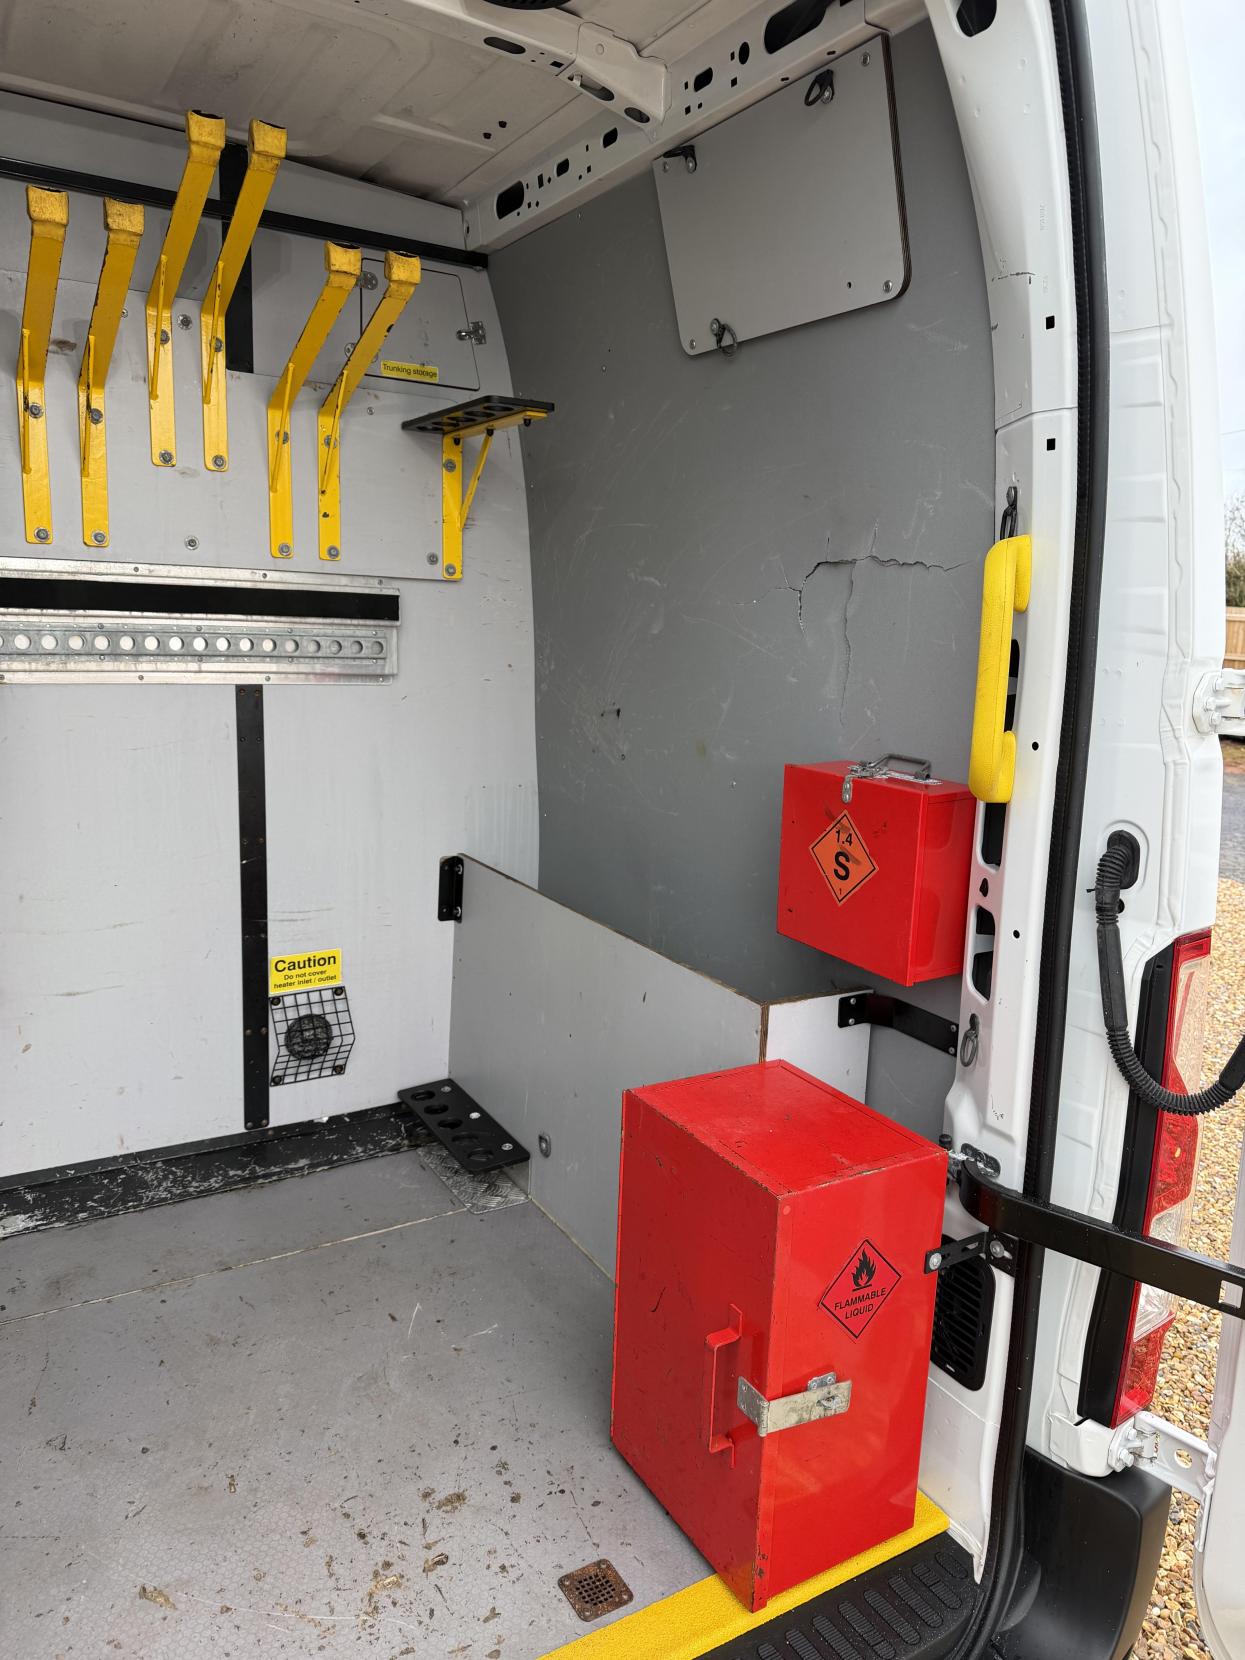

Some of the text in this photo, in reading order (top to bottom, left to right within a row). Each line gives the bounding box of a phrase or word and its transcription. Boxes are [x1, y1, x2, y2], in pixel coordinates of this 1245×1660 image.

[383, 364, 438, 378] Trunking storage
[835, 829, 852, 846] 1.4
[833, 851, 850, 881] S
[274, 955, 337, 973] Caution
[274, 981, 296, 989] heater
[297, 978, 312, 986] inlet
[317, 975, 337, 983] outlet
[834, 1287, 887, 1311] FLAMMABLE
[845, 1303, 874, 1319] LIQUID
